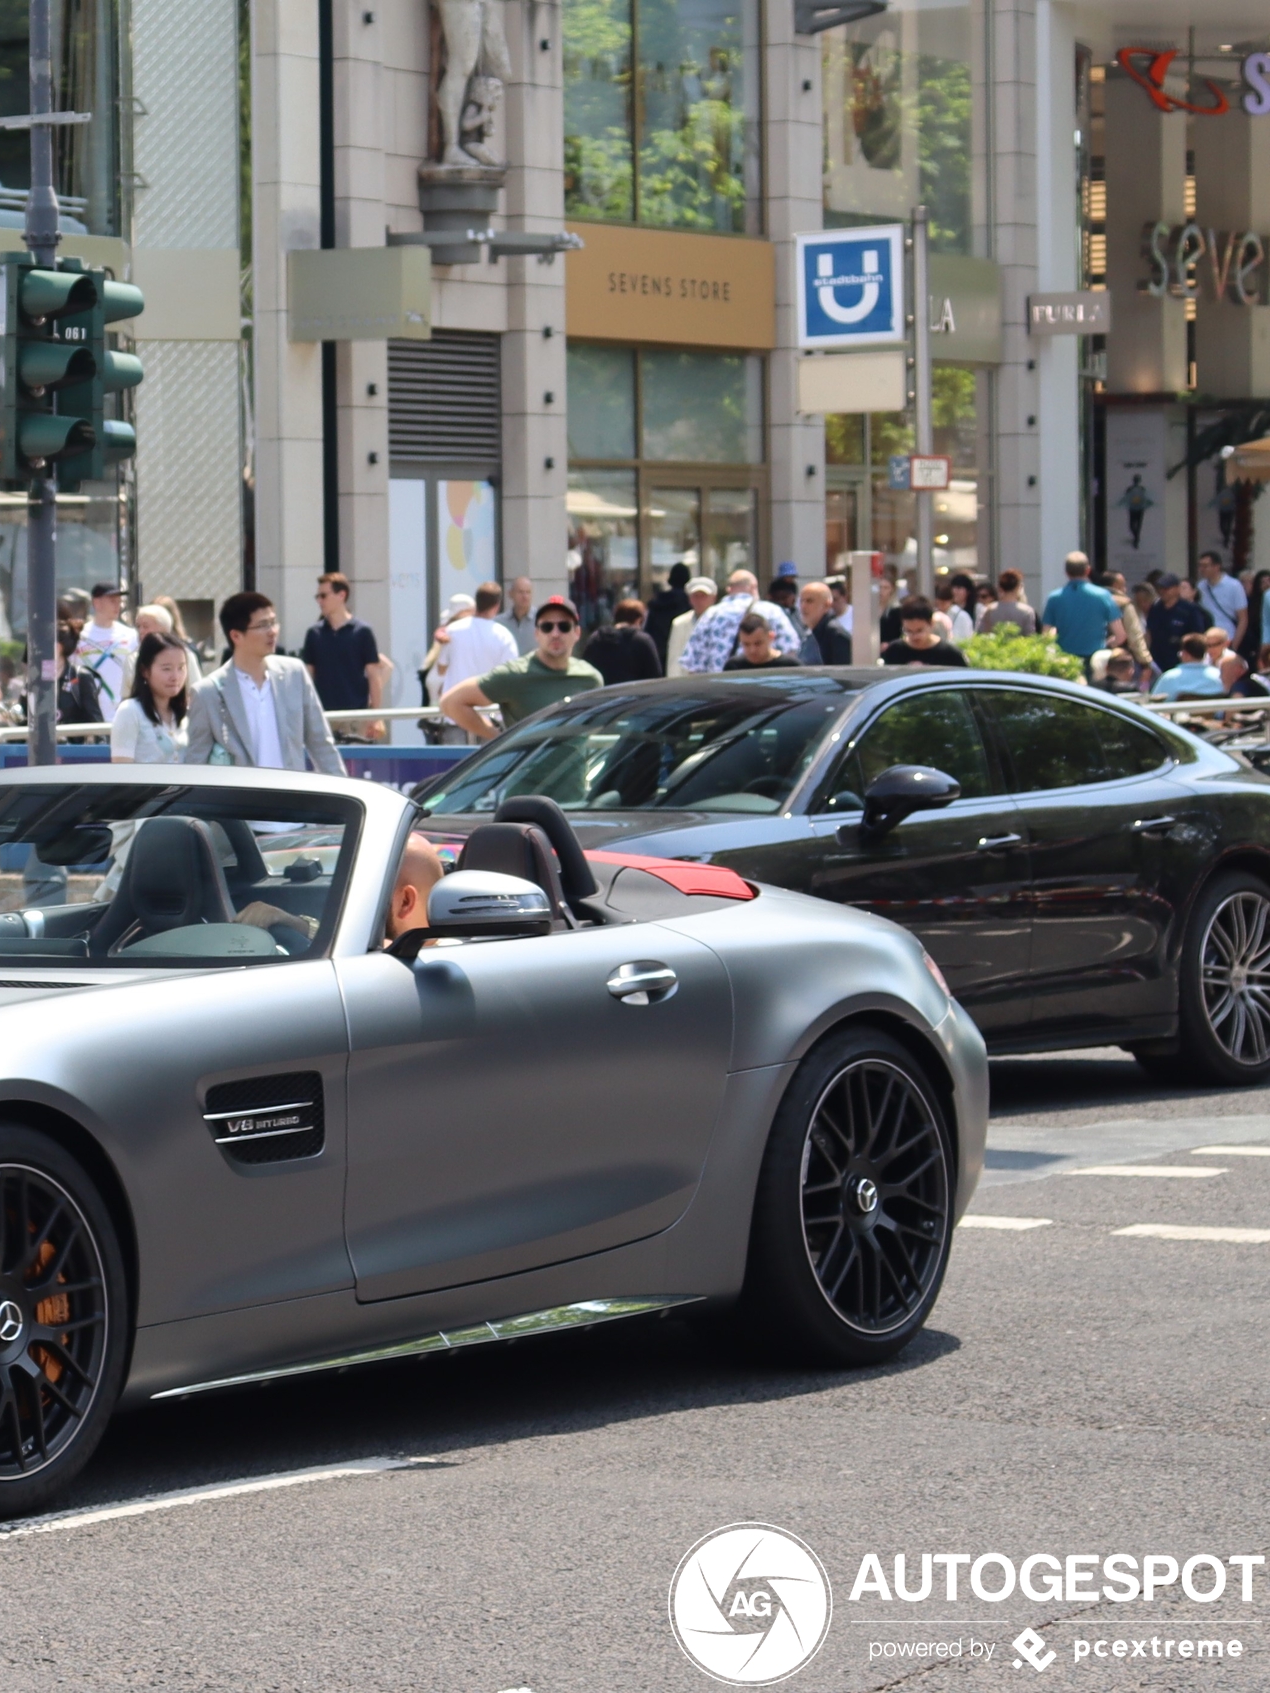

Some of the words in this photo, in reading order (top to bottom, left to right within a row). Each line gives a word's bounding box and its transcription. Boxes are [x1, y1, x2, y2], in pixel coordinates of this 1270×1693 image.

[609, 272, 672, 297] SEVENS
[680, 278, 730, 303] STORE
[813, 274, 884, 287] stadtbahn
[1033, 303, 1103, 324] FURLA
[65, 327, 86, 340] 061
[227, 1119, 253, 1132] V8
[255, 1116, 300, 1129] BITURBO
